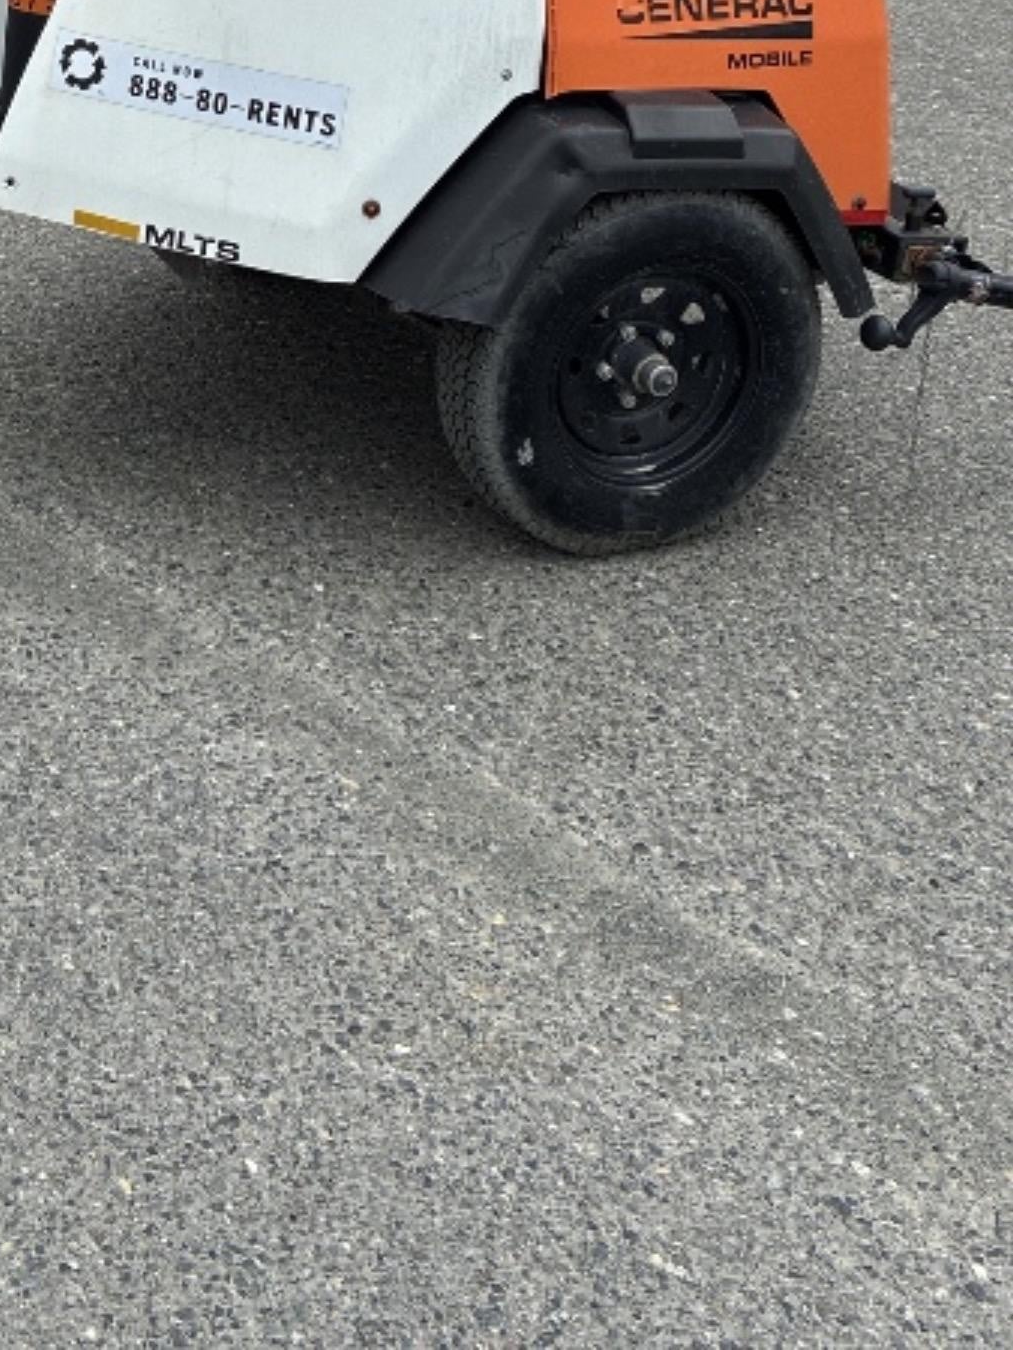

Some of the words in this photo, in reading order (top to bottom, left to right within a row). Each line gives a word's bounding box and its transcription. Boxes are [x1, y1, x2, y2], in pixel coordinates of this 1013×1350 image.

[133, 56, 166, 73] CALL
[172, 64, 204, 80] NOW
[727, 50, 813, 70] MOBILE
[128, 74, 337, 136] 888-80-RENTS
[145, 225, 241, 262] MLTS
